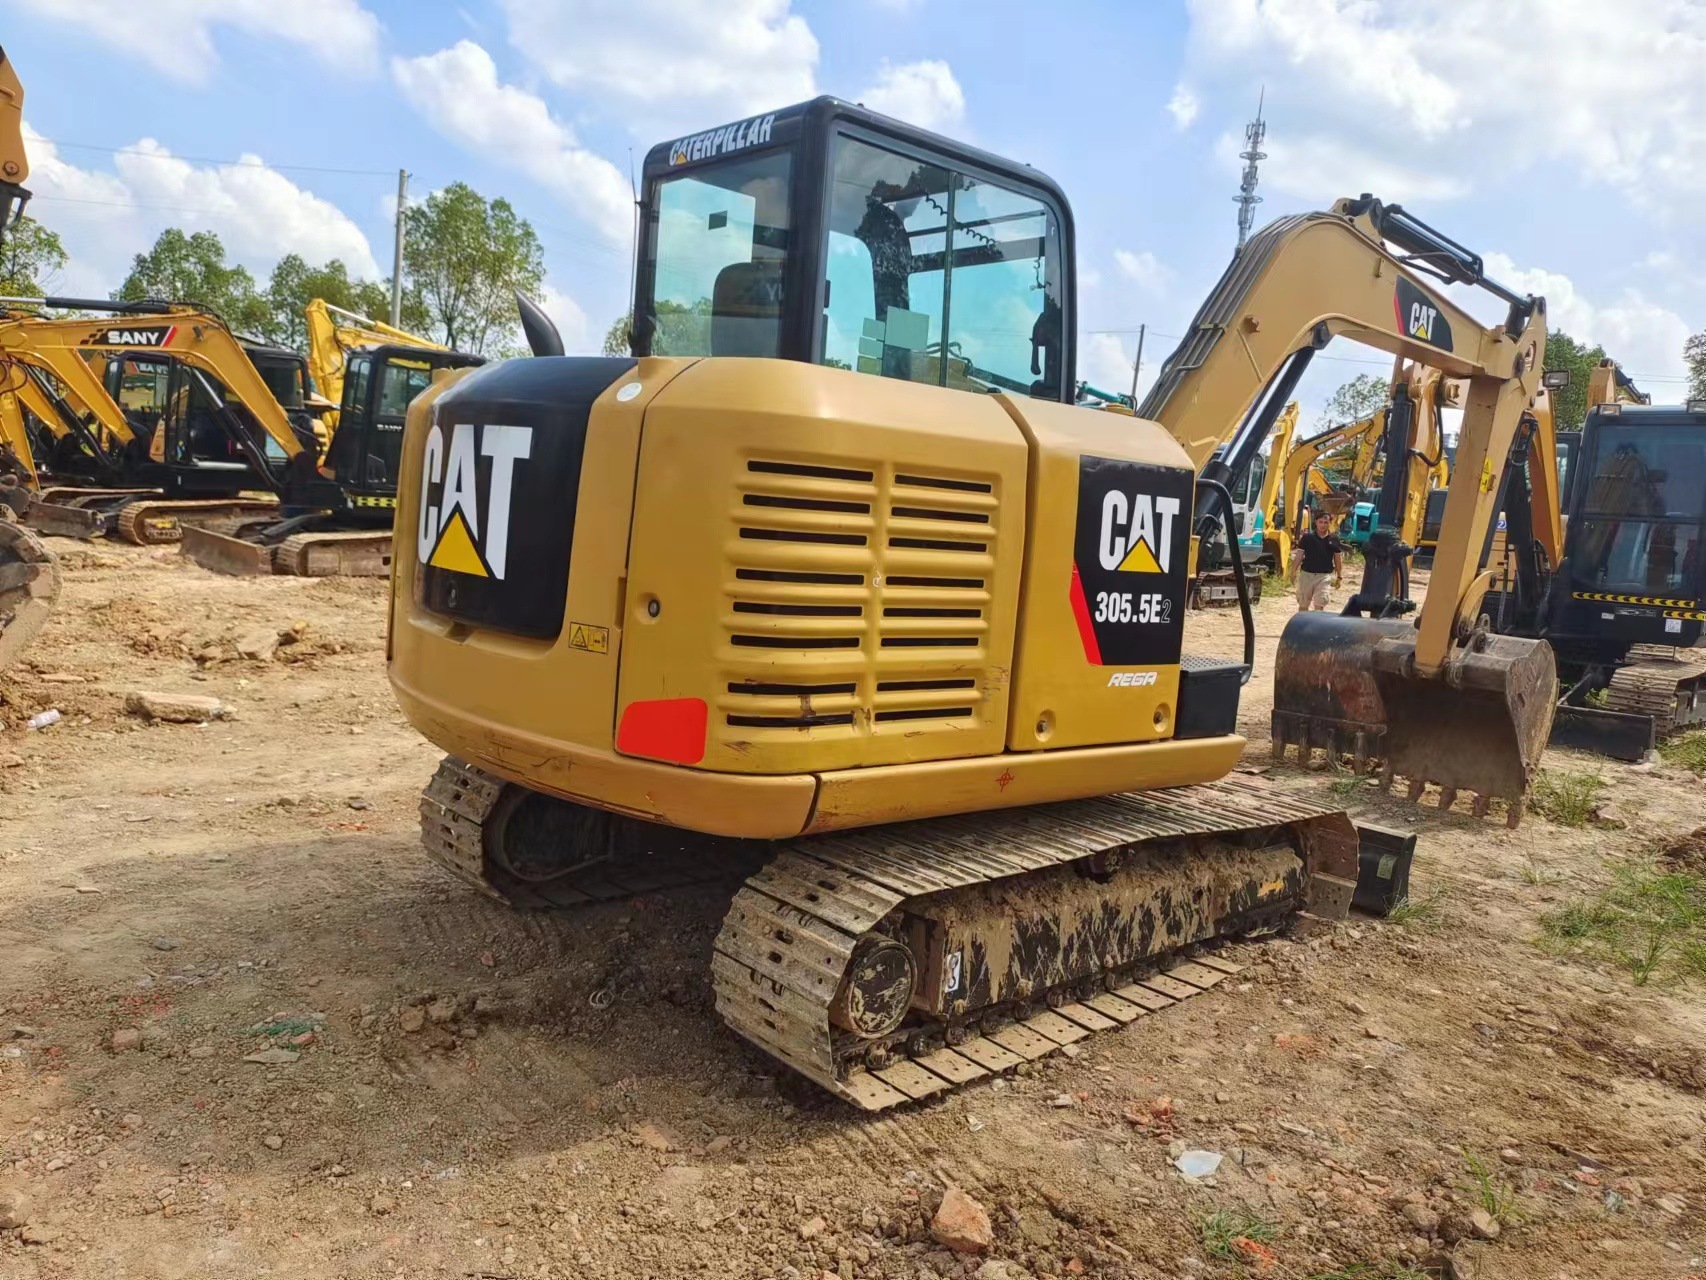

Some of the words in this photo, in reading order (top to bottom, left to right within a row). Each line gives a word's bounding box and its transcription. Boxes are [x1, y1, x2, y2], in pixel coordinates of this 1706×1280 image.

[669, 115, 775, 166] CATERPILLAR
[108, 330, 159, 345] SANY
[1409, 302, 1437, 341] CAT
[418, 424, 533, 580] CAT
[1099, 489, 1180, 574] CAT
[1095, 591, 1171, 624] 305.5E2
